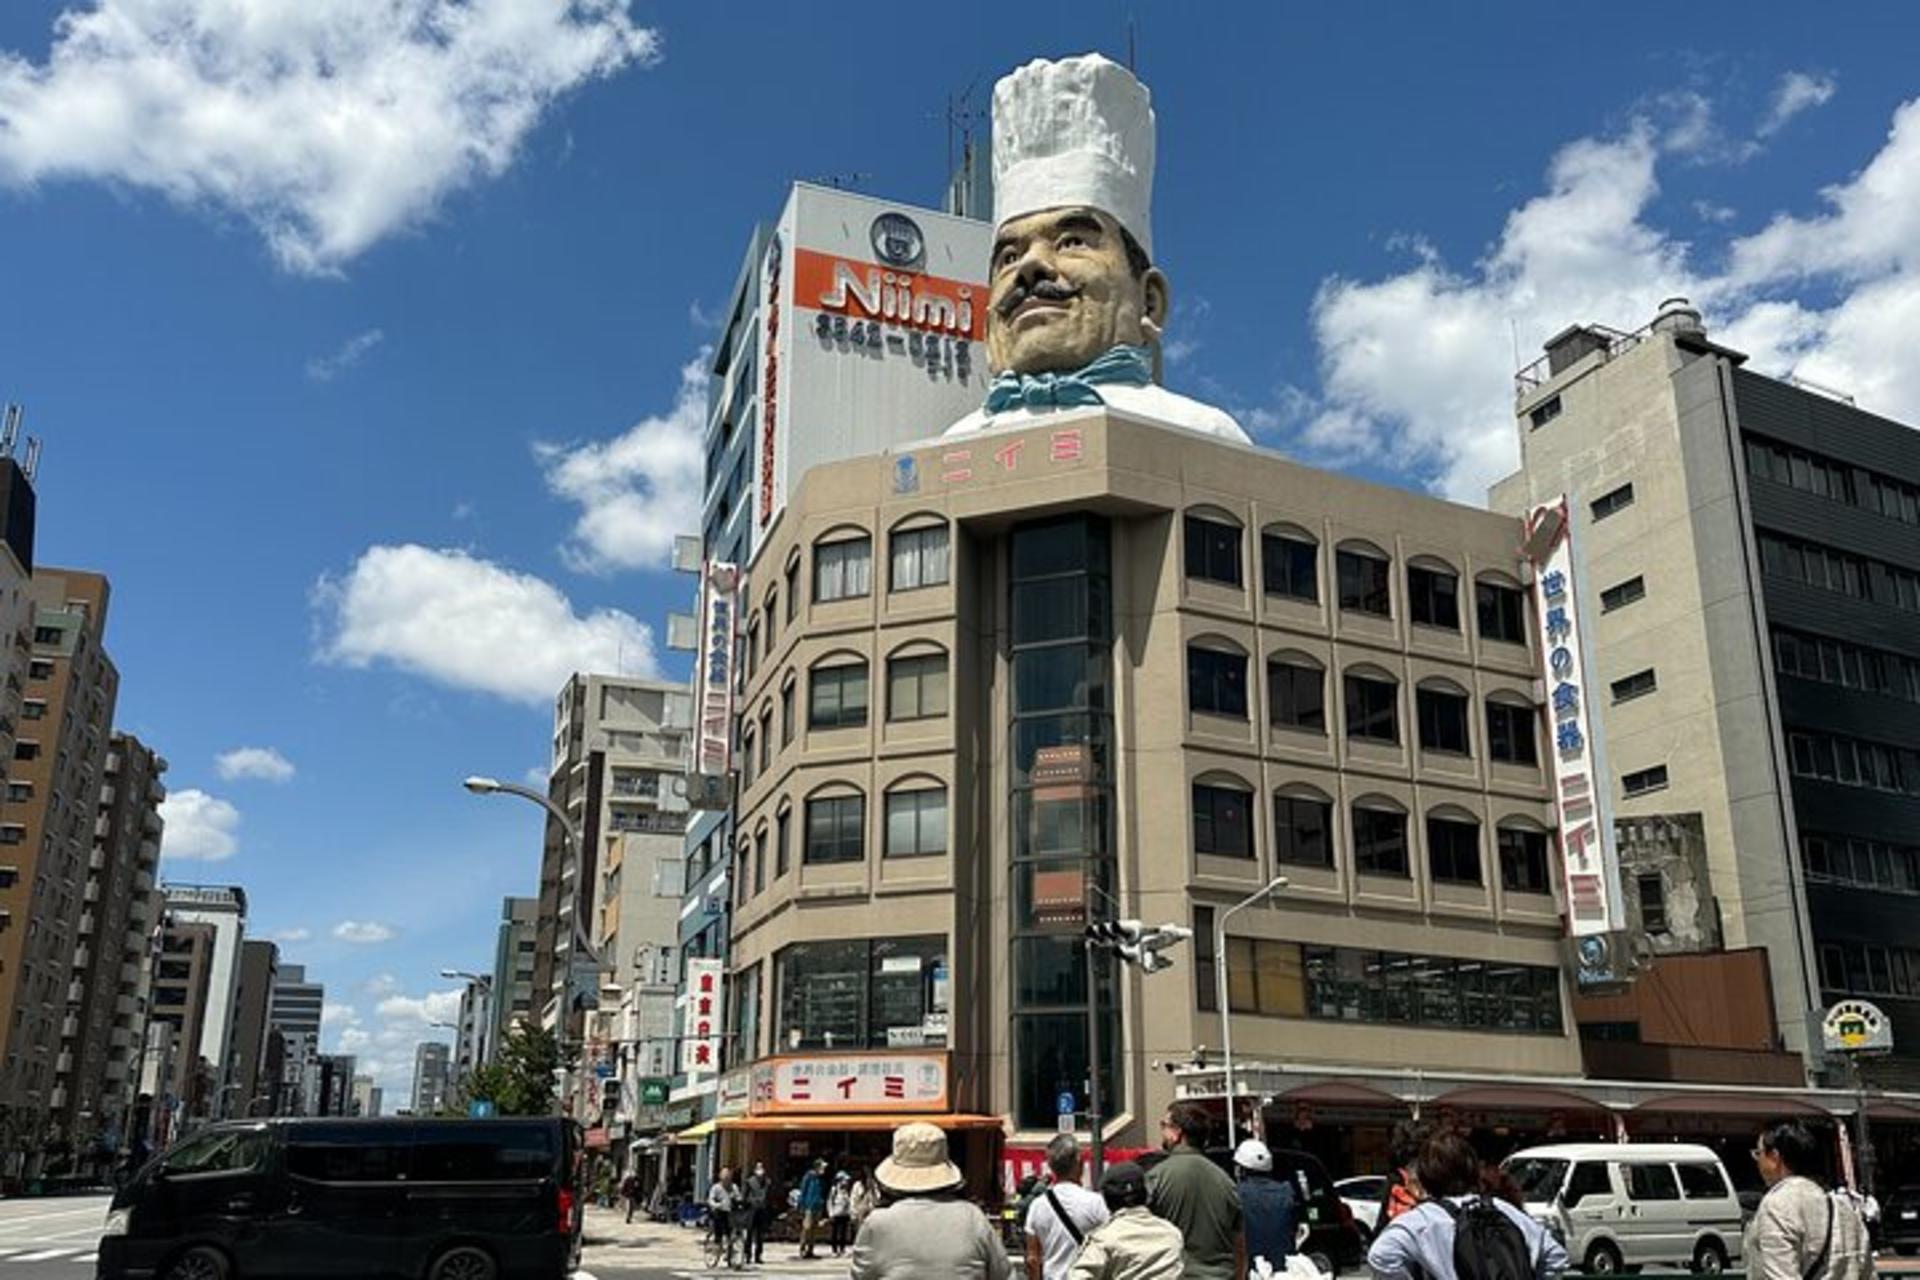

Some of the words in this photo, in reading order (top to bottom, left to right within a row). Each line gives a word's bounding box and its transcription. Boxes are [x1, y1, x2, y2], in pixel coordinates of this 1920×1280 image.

[819, 261, 972, 332] Niimi
[941, 429, 1081, 482] ニイミ
[792, 1077, 905, 1099] ニイミ
